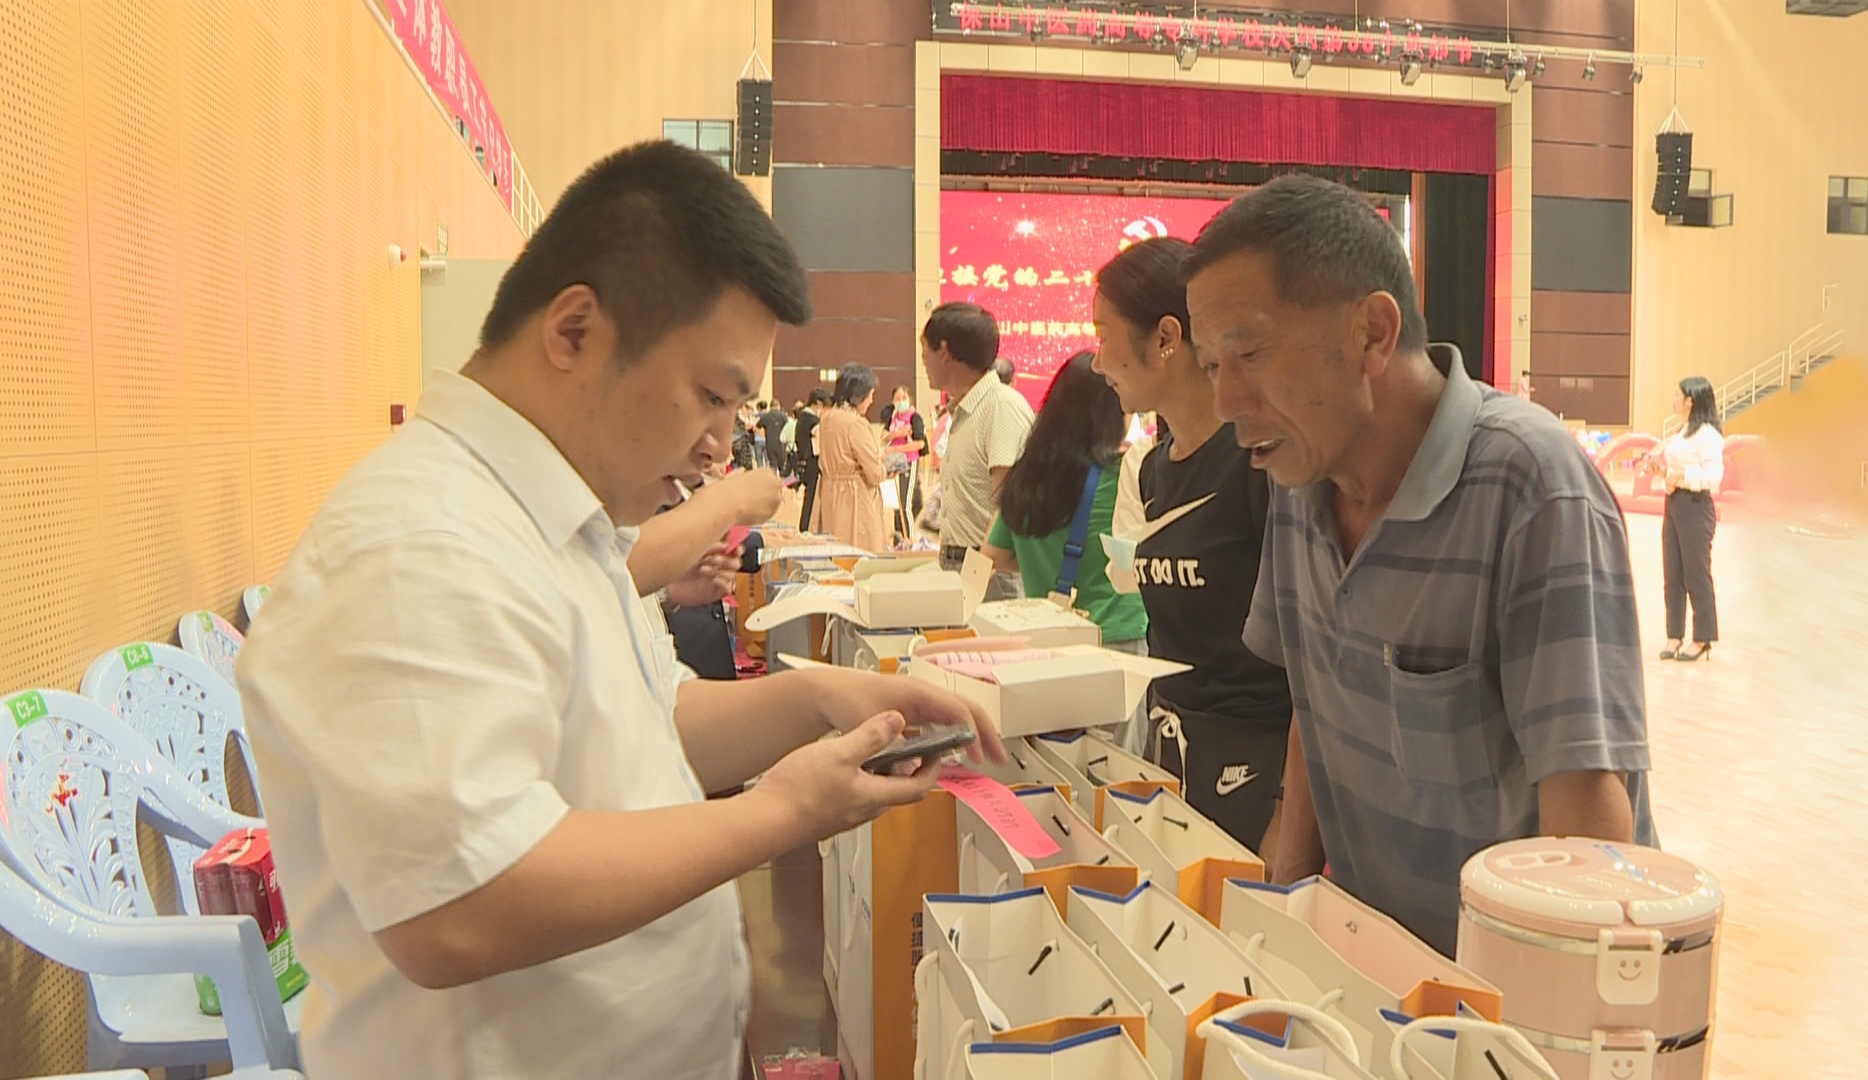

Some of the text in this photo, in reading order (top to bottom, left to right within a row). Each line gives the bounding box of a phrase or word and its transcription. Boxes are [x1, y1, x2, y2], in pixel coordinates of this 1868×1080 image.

[1150, 557, 1174, 585] DO
[1177, 558, 1206, 587] IT.
[15, 695, 41, 720] C3-7
[1221, 764, 1249, 783] NIKE
